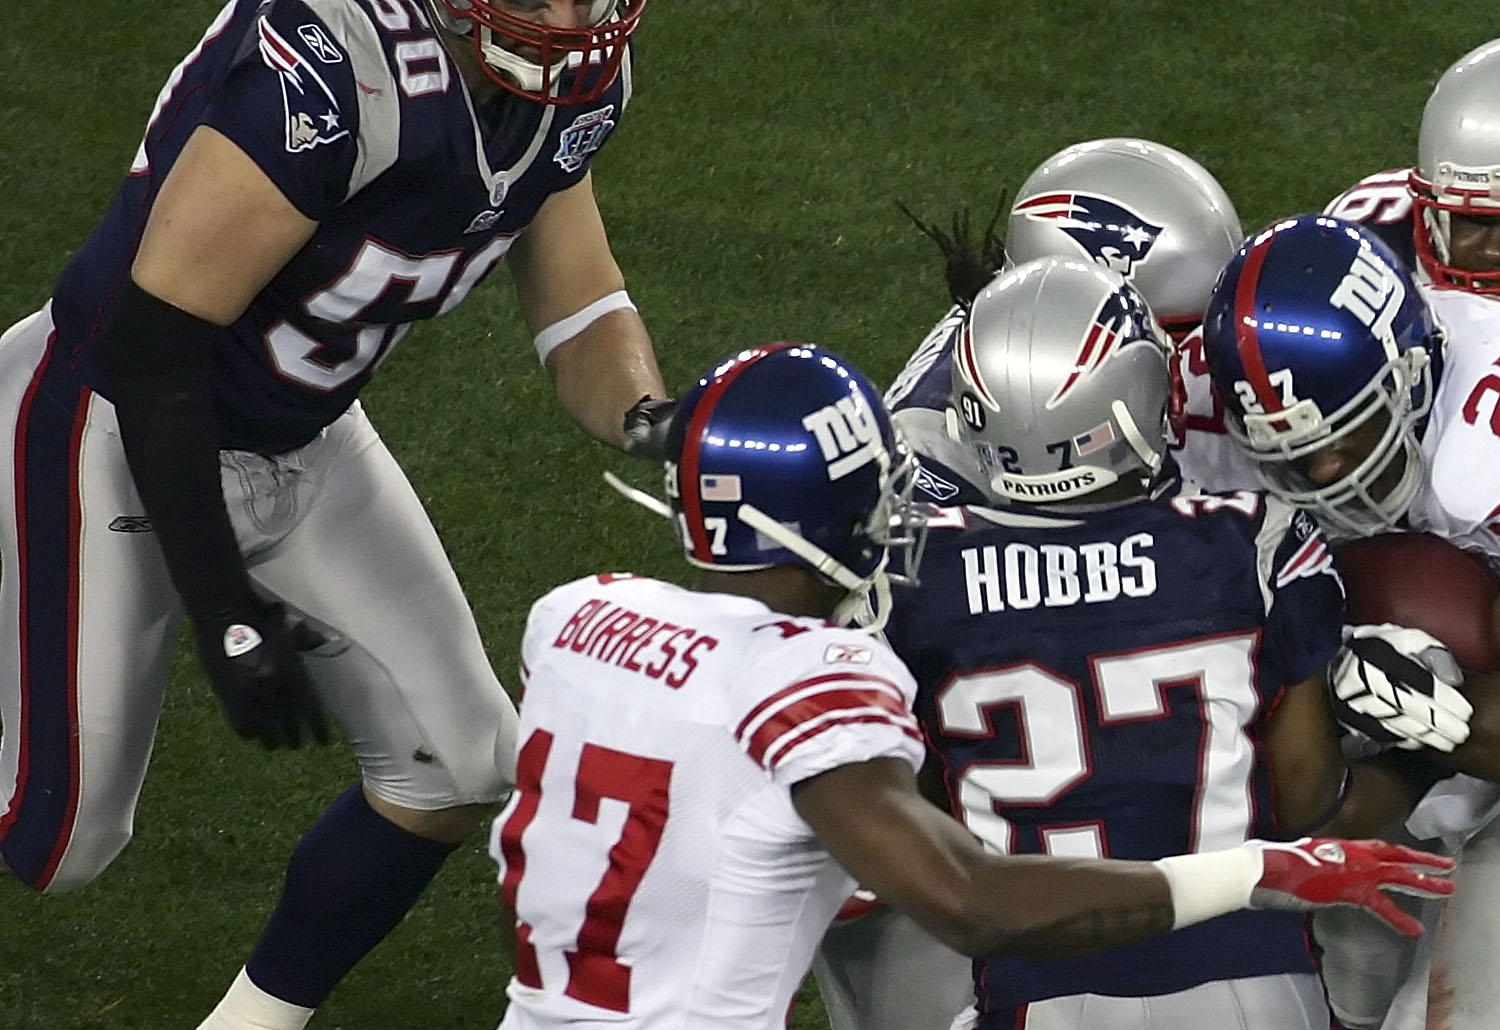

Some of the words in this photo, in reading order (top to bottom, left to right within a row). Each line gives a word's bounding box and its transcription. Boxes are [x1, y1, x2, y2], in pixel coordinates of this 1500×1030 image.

[1003, 472, 1097, 496] PATRIOTS
[961, 532, 1157, 615] HOBBS
[552, 597, 718, 690] BURRESS
[938, 629, 1263, 859] 27
[502, 727, 675, 1014] 17
